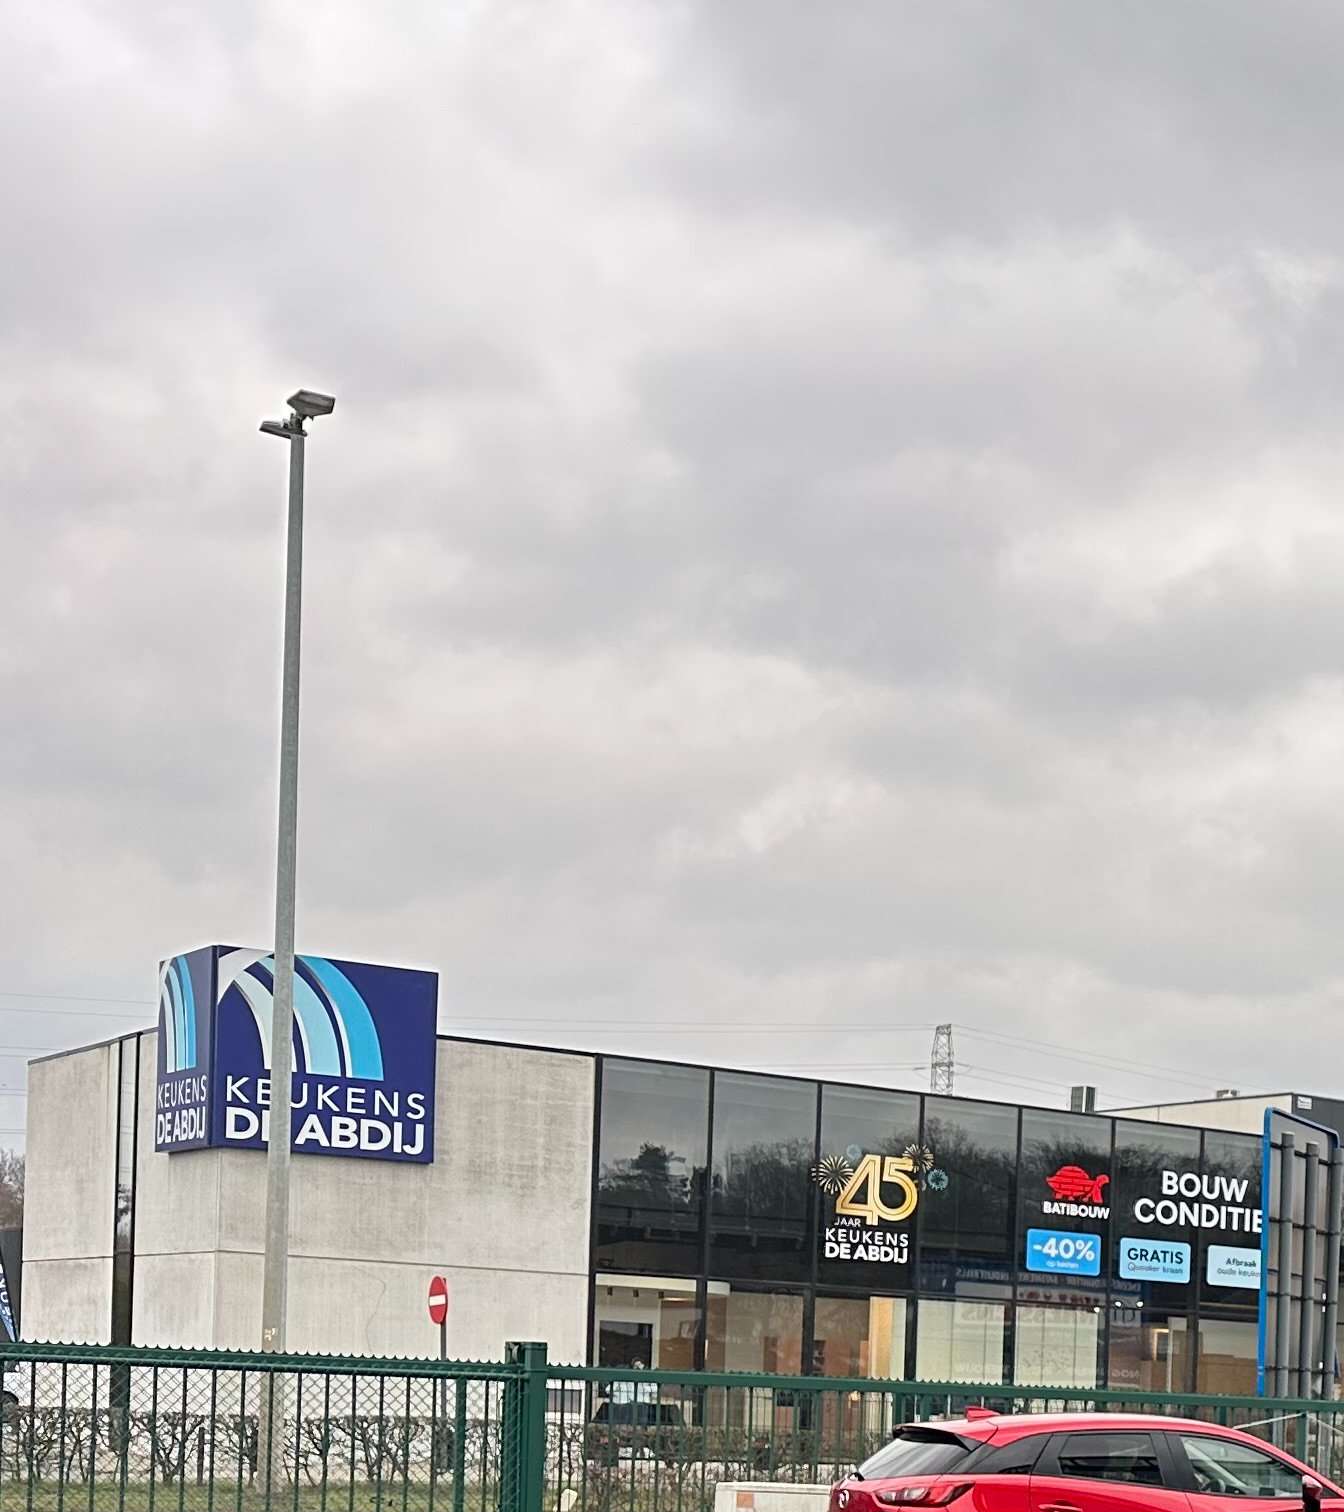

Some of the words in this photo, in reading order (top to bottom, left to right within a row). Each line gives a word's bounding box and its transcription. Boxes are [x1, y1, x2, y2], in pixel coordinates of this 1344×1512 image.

[157, 1074, 207, 1109] KEUKENS
[225, 1075, 426, 1120] KEUKENS
[156, 1112, 173, 1145] DE
[172, 1106, 206, 1142] ABDIJ
[294, 1113, 425, 1156] ABDIJ
[835, 1153, 918, 1226] 45
[1161, 1170, 1249, 1203] BOUW
[834, 1217, 861, 1228] JAAR
[1043, 1200, 1110, 1219] BATIBOUW
[1134, 1197, 1263, 1233] CONDITIE
[824, 1241, 852, 1260] DE
[852, 1244, 909, 1264] ABDIJ
[825, 1227, 909, 1247] KEUKENS
[1033, 1237, 1096, 1262] -40%
[1127, 1247, 1184, 1265] GRATIS
